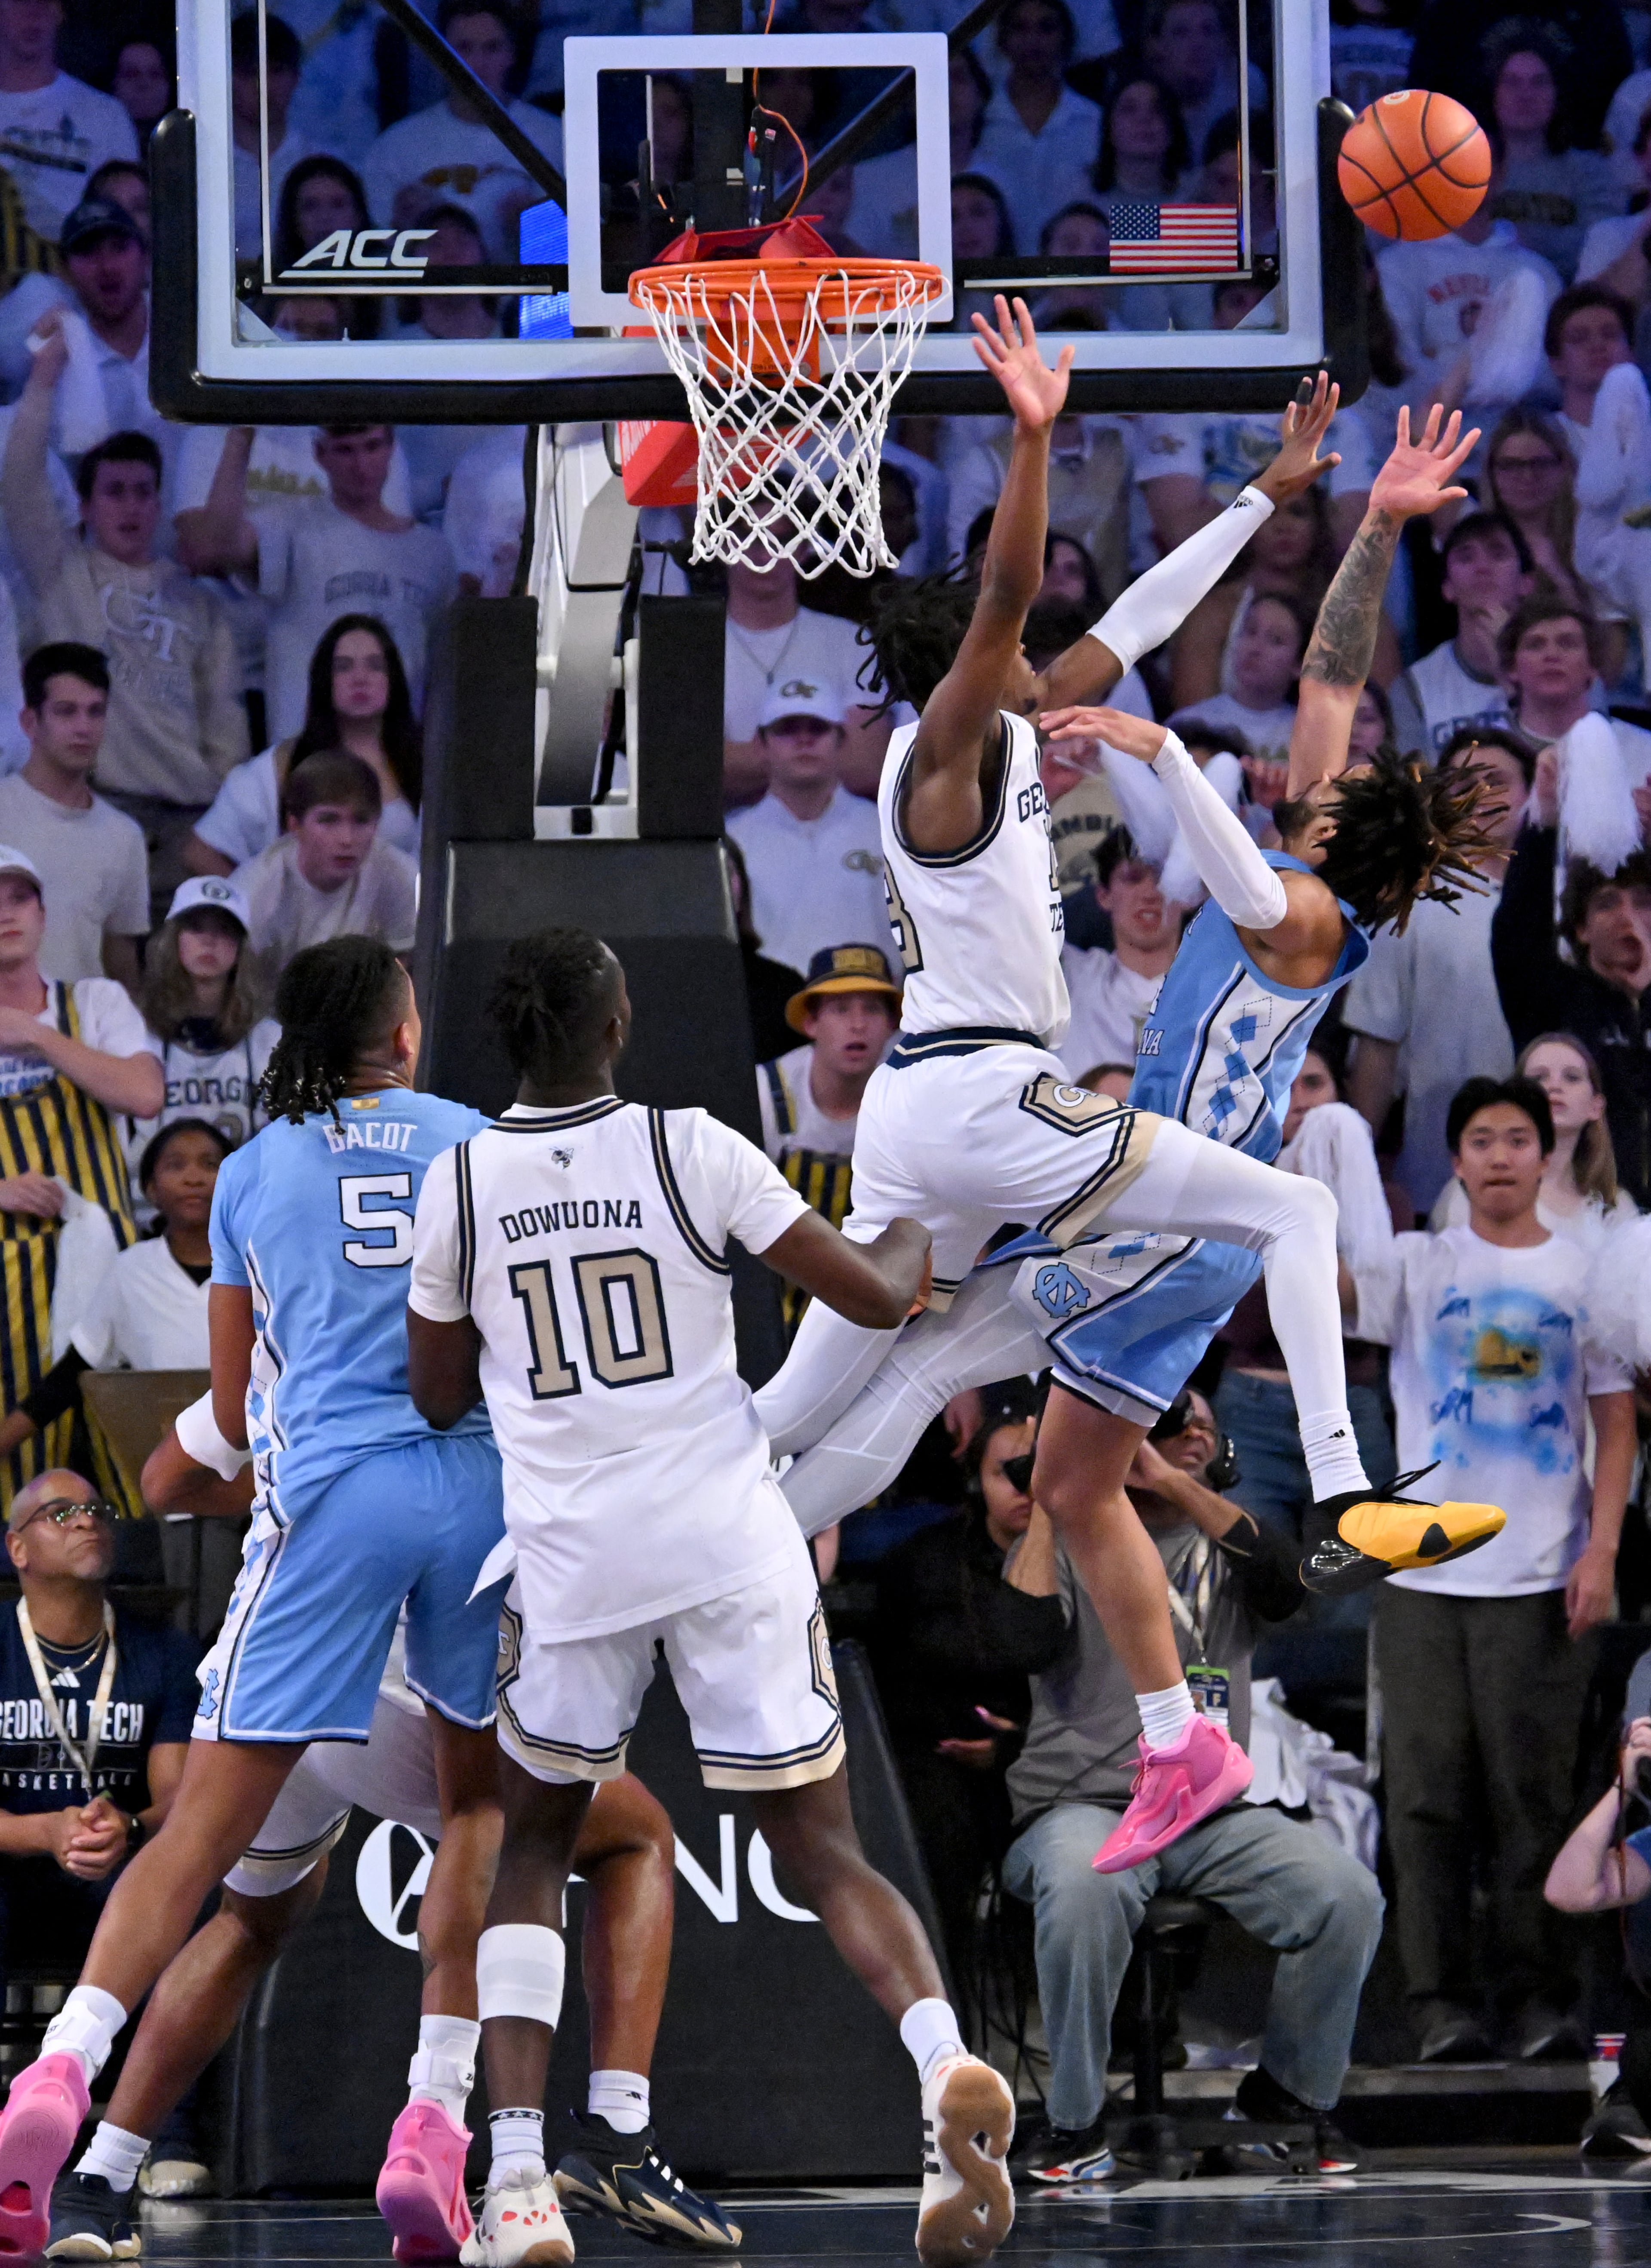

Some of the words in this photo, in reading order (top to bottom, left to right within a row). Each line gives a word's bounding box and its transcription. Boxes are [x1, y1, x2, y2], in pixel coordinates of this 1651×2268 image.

[292, 230, 439, 267] ACC
[322, 1122, 418, 1154] BACOT
[338, 1171, 415, 1269] 5
[498, 1199, 643, 1243] DOWUONA
[507, 1247, 674, 1401] 10
